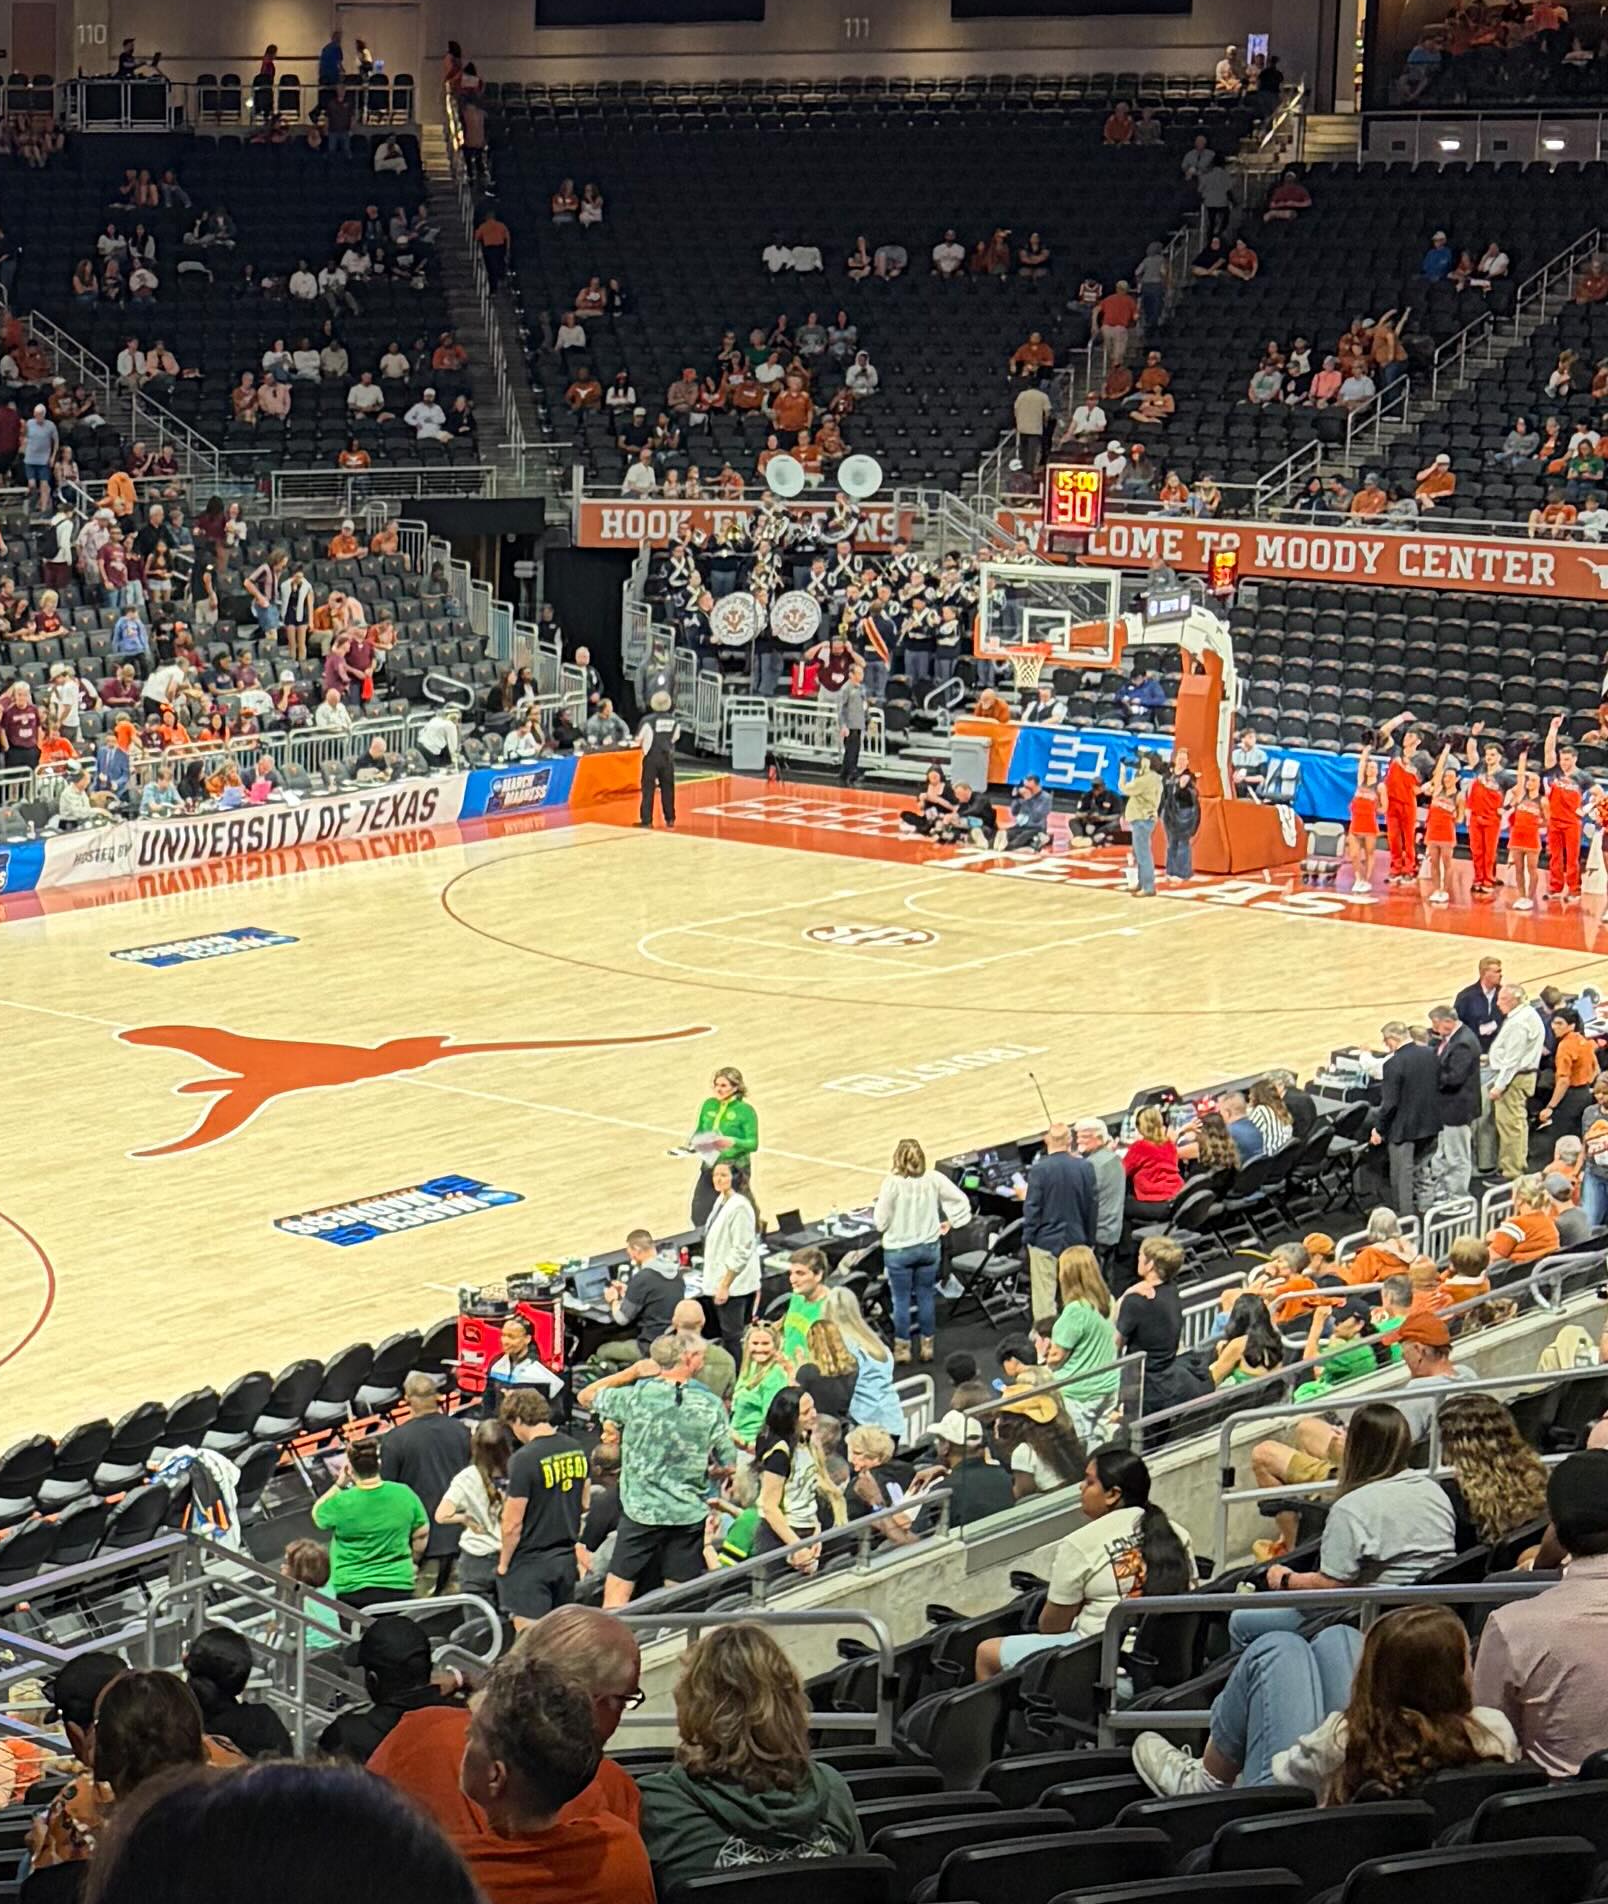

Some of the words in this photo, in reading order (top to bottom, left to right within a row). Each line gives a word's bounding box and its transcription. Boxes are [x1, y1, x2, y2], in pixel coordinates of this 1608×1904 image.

[76, 24, 106, 46] 110
[1058, 471, 1098, 492] 15:00
[1057, 491, 1092, 523] 30
[600, 509, 692, 540] HOOK
[1016, 520, 1183, 561] WCOME
[1255, 535, 1384, 577] MOODY
[1399, 544, 1556, 588] CENTER
[73, 846, 115, 866] HOSTED
[138, 803, 310, 867] UNIVERSITY
[317, 804, 351, 841] OF
[356, 787, 441, 834] TEXAS
[922, 846, 1379, 915] TEAS
